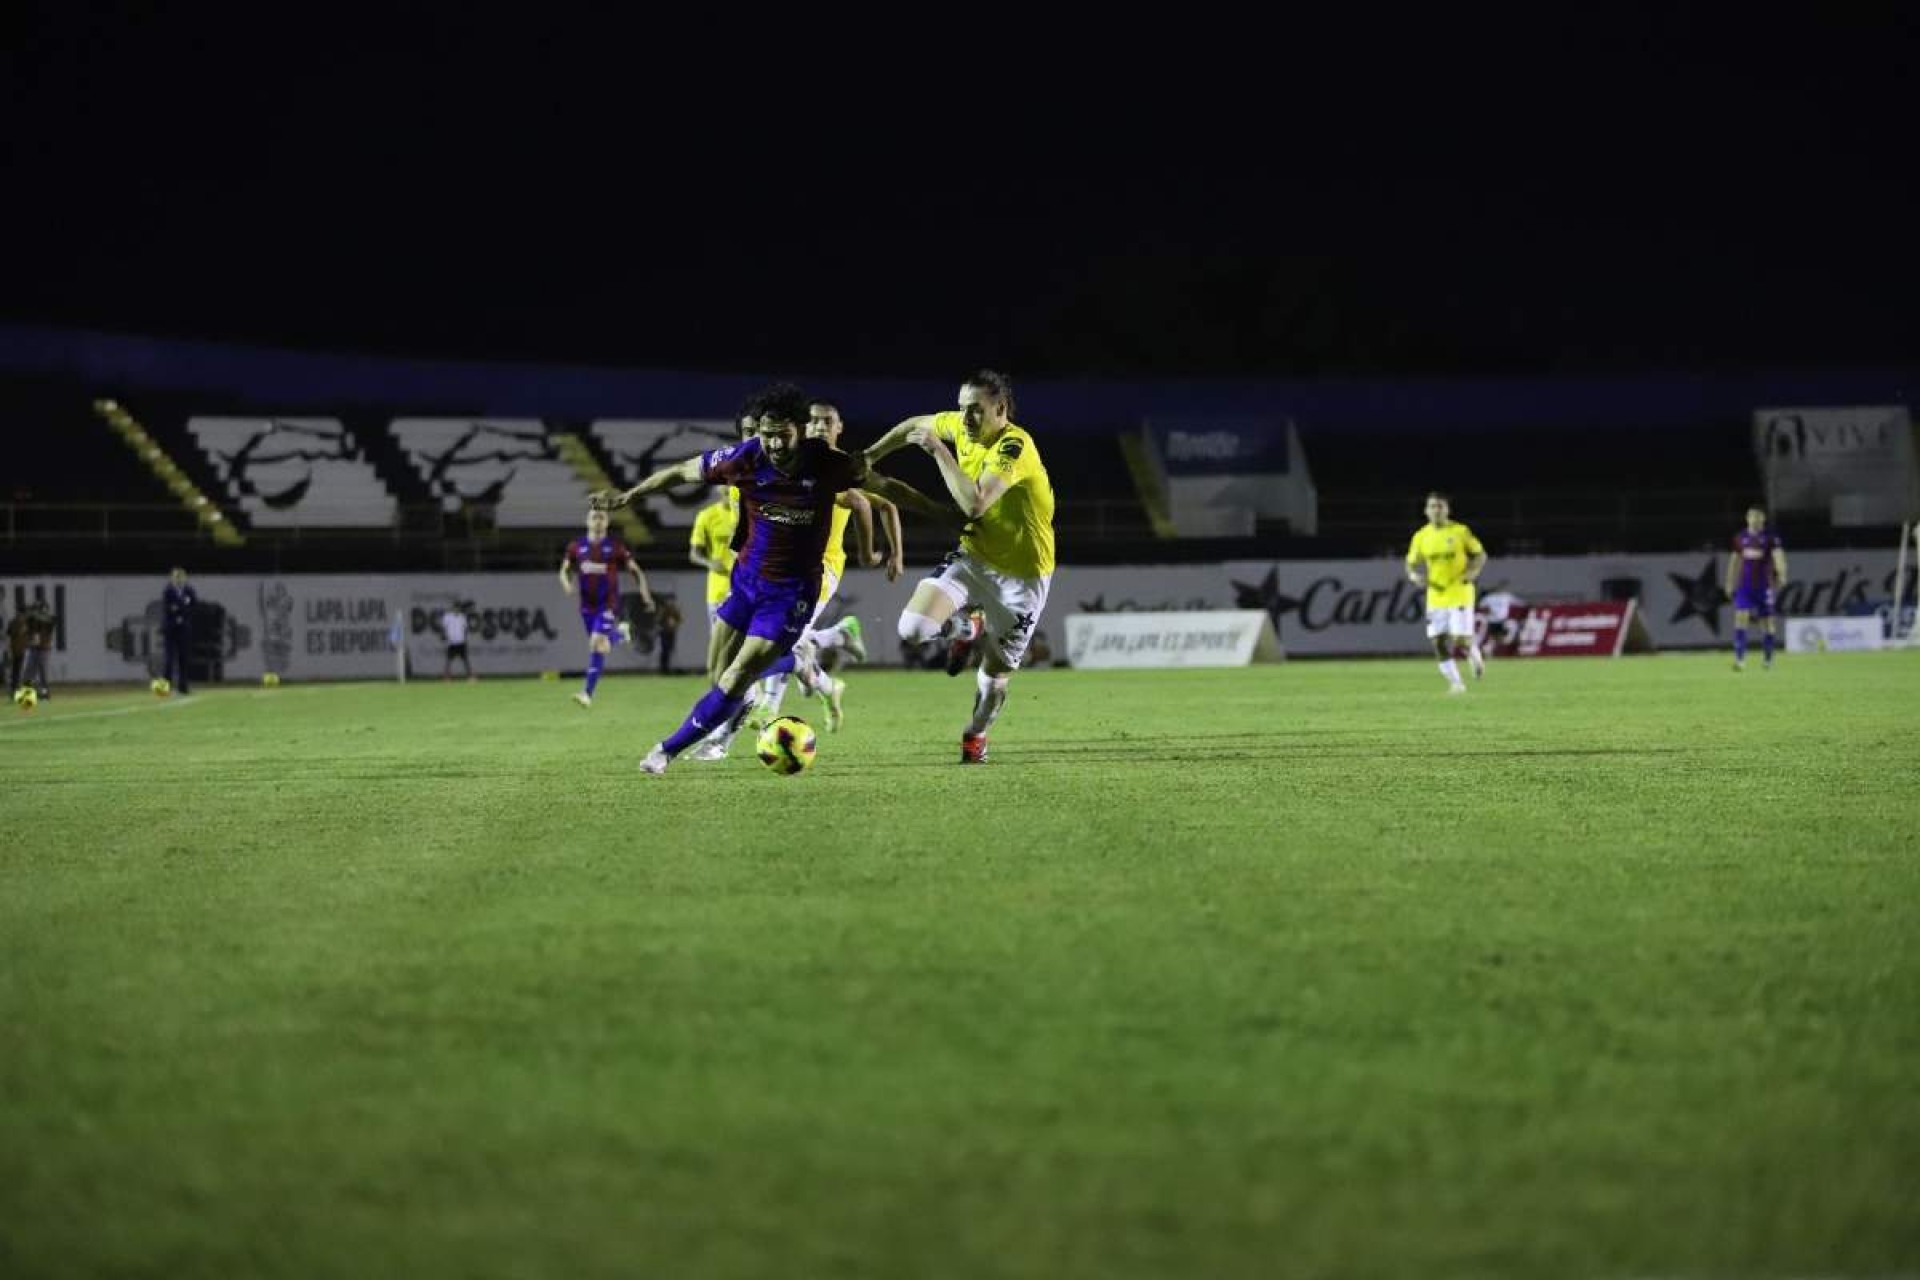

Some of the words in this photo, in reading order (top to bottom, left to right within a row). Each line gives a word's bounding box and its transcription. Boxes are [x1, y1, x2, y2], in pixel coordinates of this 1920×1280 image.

[1299, 577, 1425, 631] Carls
[1775, 565, 1869, 614] arl's
[306, 599, 344, 622] LAPA
[349, 599, 385, 623] LAPA
[411, 606, 557, 640] DOSUSA
